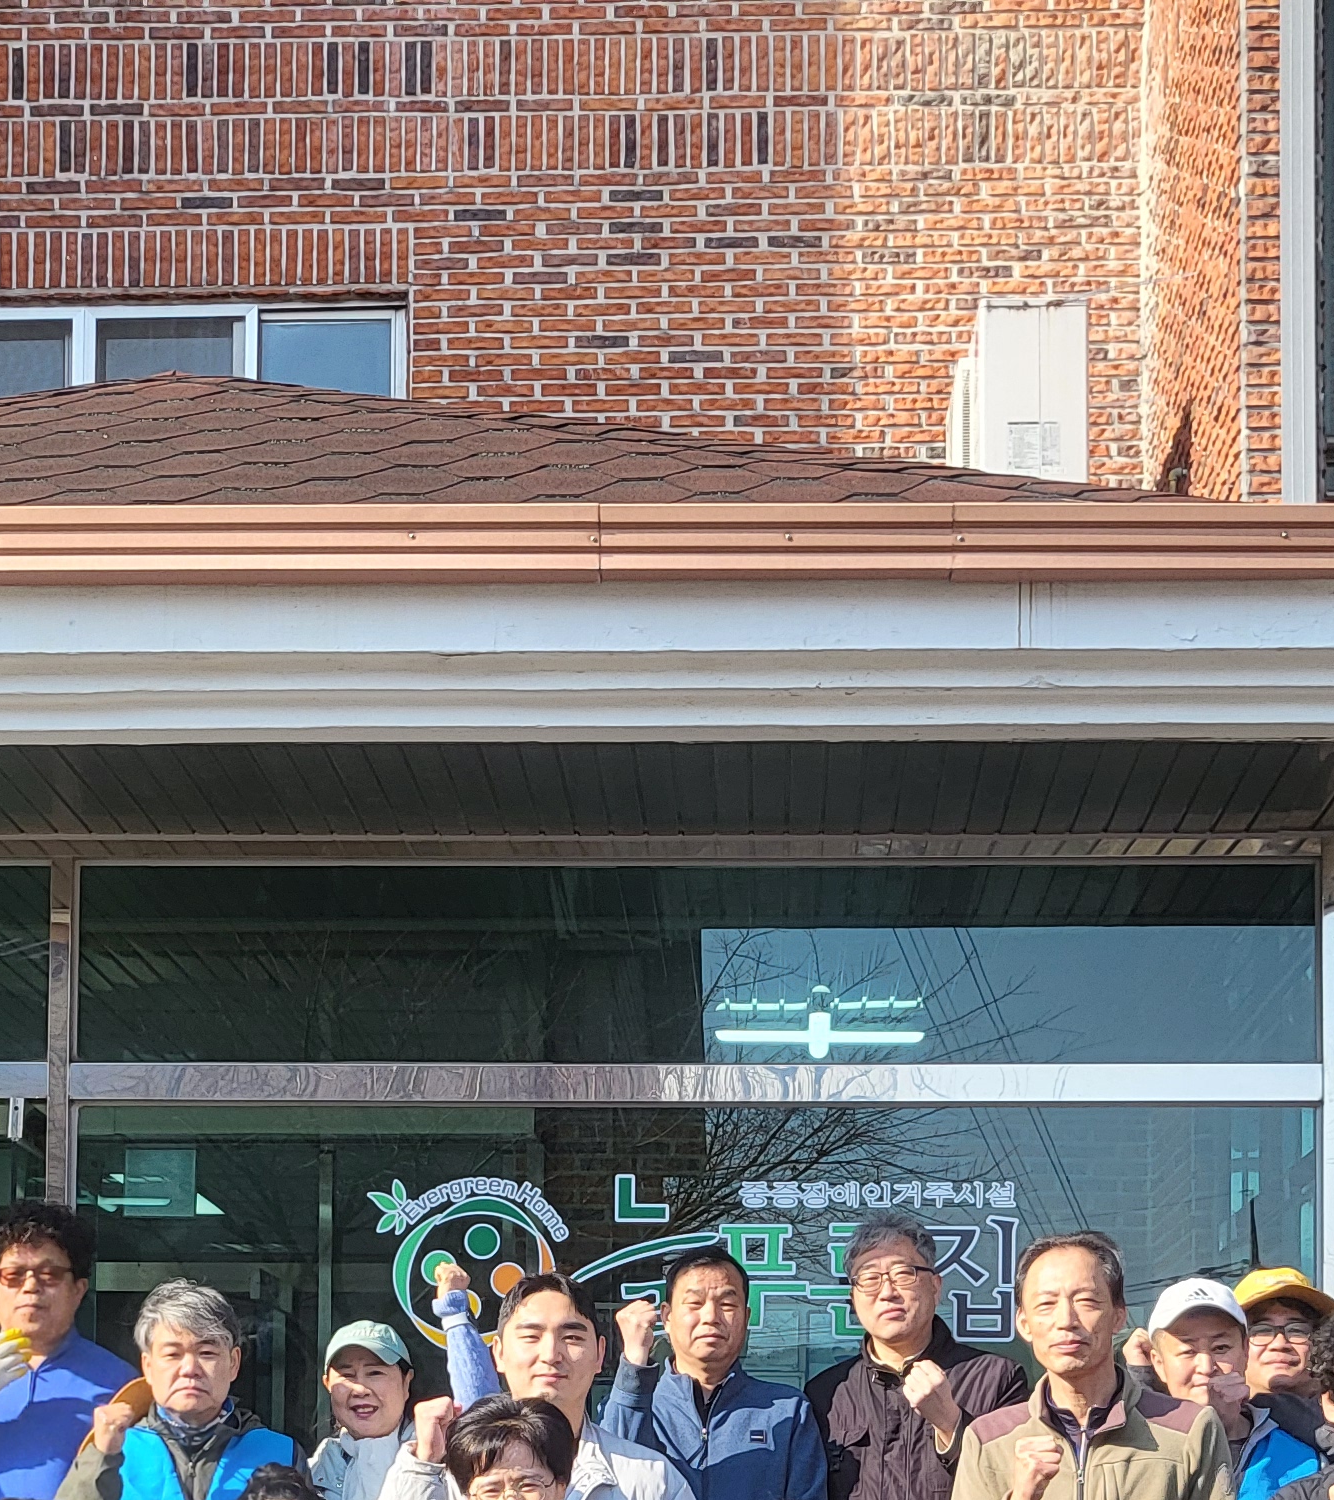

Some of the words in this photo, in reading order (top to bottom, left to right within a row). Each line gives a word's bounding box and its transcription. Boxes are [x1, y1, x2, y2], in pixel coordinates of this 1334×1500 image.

[400, 1177, 517, 1225] Evergreen
[517, 1181, 570, 1242] Home
[738, 1180, 1017, 1210] 중증장애인거주시설
